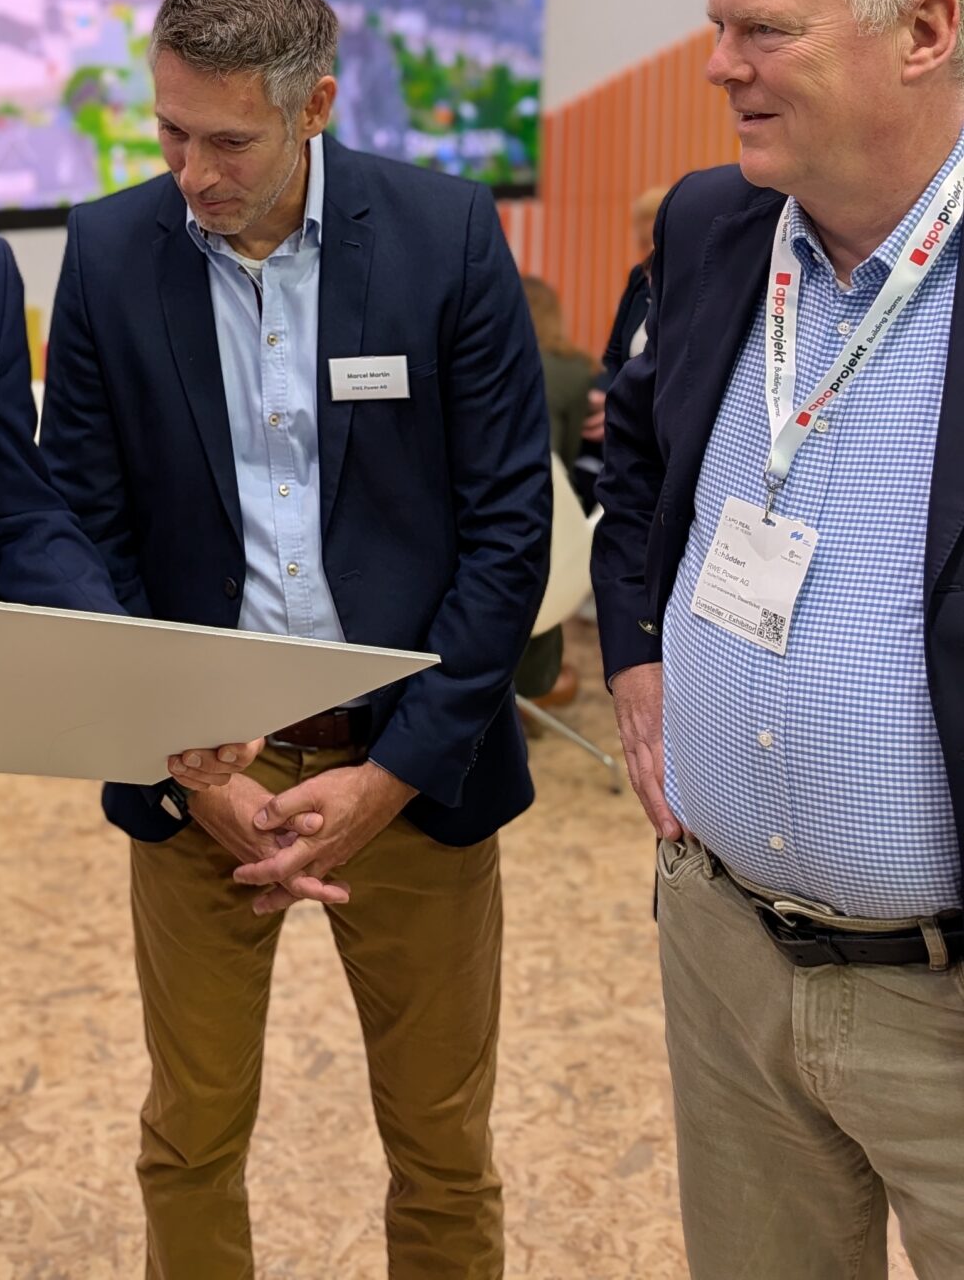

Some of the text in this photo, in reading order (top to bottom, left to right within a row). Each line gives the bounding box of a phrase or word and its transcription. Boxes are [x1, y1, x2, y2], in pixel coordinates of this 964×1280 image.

[771, 287, 786, 363] apoprojekt
[808, 344, 868, 411] apoprojekt
[866, 316, 888, 344] Building
[722, 569, 740, 582] Power
